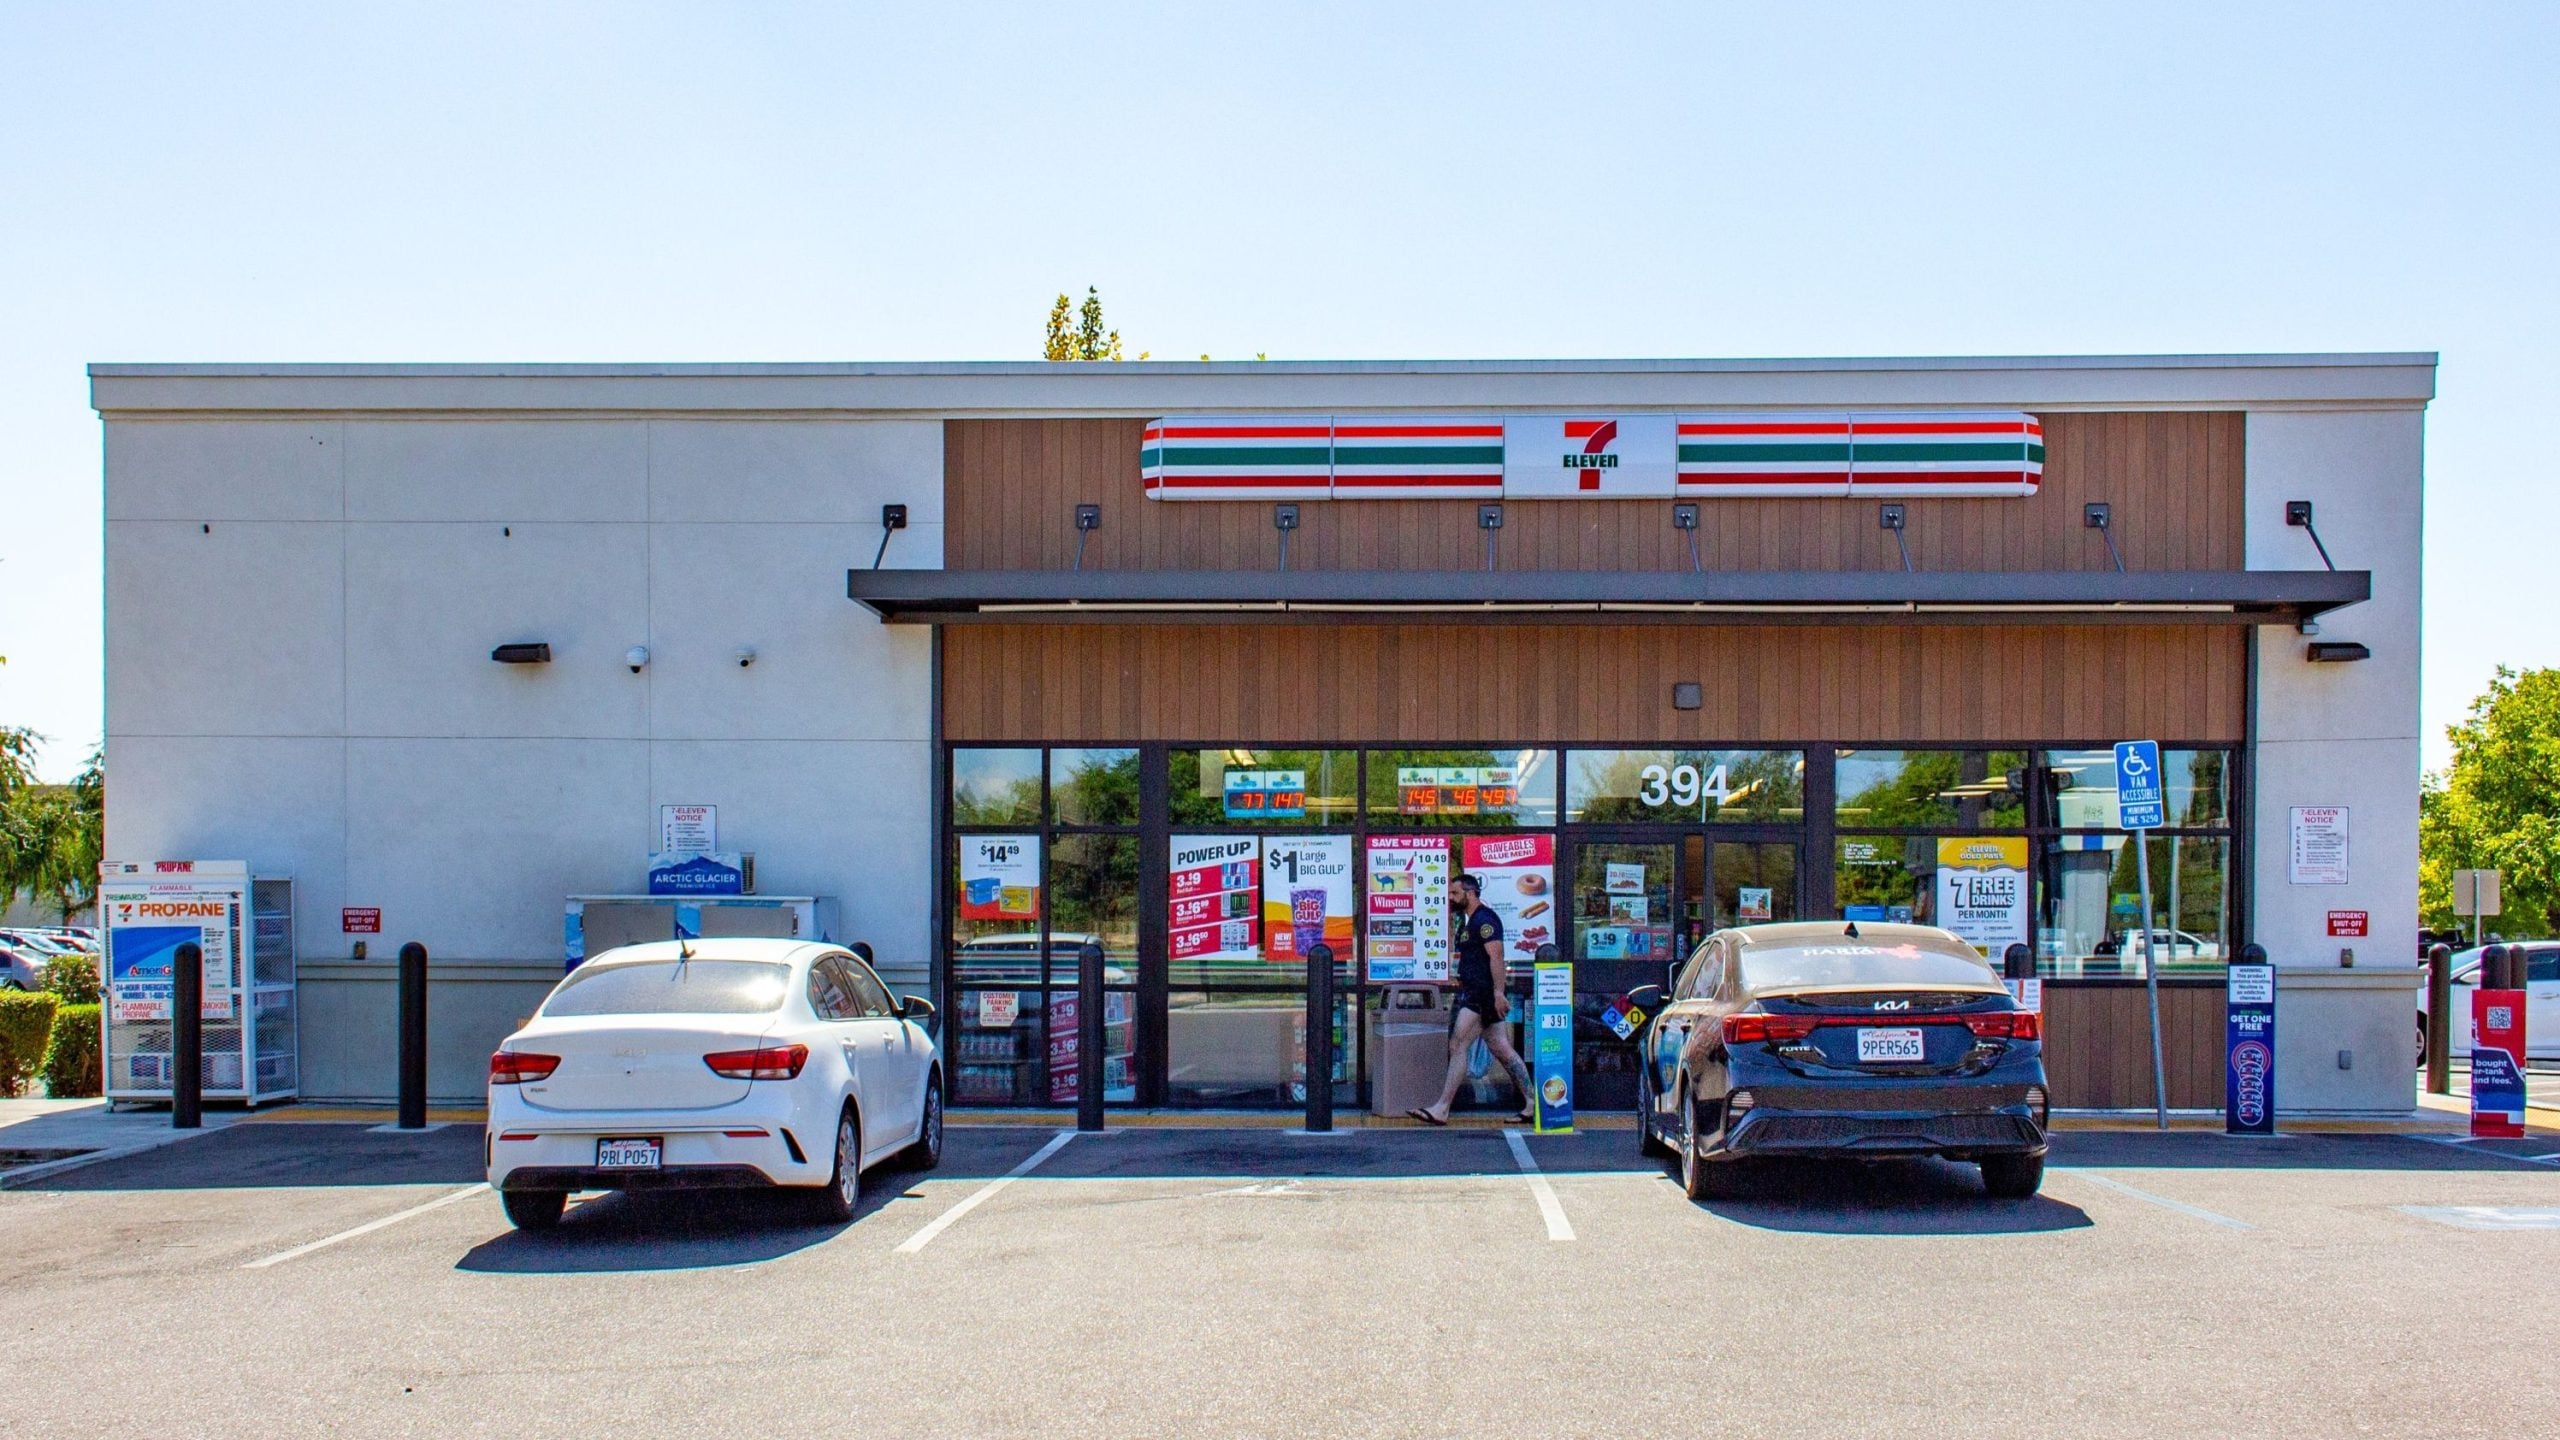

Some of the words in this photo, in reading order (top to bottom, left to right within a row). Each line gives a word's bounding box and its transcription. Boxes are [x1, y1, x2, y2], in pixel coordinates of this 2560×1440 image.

[1640, 764, 1730, 807] 394
[2130, 776, 2147, 788] VAN
[1243, 793, 1264, 808] 77
[1275, 793, 1303, 808] 147
[1407, 789, 1437, 805] 145
[1453, 789, 1476, 805] 46
[2121, 788, 2158, 802] ACCESSIBLE
[2127, 805, 2154, 815] MINIMUM
[2124, 816, 2139, 825] FINE
[1371, 838, 1399, 847] SAVE
[1413, 838, 1436, 847] BUY
[1437, 838, 1445, 847] 2
[1481, 839, 1534, 855] CRAVEABLES
[1177, 845, 1224, 865] POWER
[1226, 841, 1251, 857] UP
[1300, 851, 1326, 863] Large
[1482, 851, 1509, 861] VALUE
[1510, 848, 1535, 857] MENU
[156, 861, 193, 872] PROPANE
[1269, 848, 1298, 883] $1
[1375, 853, 1407, 867] Marlboro
[1300, 865, 1316, 875] BIG
[1319, 864, 1344, 875] GULP
[655, 874, 692, 883] ARCTIC
[694, 874, 736, 883] GLACIER
[1176, 874, 1185, 887] 3
[1970, 876, 2015, 894] FREE
[1950, 876, 1970, 908] 7
[1374, 896, 1410, 907] Winston
[1970, 893, 2015, 908] DRINKS
[139, 903, 225, 917] PROPANE
[1176, 903, 1185, 917] 3
[1295, 911, 1321, 921] GULP
[1958, 910, 1976, 919] PER
[1976, 910, 2007, 919] MONTH
[1176, 935, 1185, 948] 3
[1590, 933, 1599, 945] 3
[129, 964, 173, 976] AmeriG
[121, 1002, 163, 1010] FLAMMABLE
[1873, 1000, 1910, 1010] KIA
[122, 1010, 151, 1018] PROPANE
[1050, 1006, 1058, 1020] 3
[1607, 1011, 1617, 1024] 3
[2230, 1015, 2249, 1023] GET
[2250, 1015, 2272, 1023] ONE
[1617, 1023, 1630, 1033] SA
[2239, 1023, 2263, 1031] FREE
[1871, 1031, 1907, 1040] California
[1050, 1042, 1058, 1056] 3
[1862, 1040, 1919, 1056] 9PER565
[2475, 1060, 2507, 1069] bought
[1052, 1076, 1060, 1090] 3
[2473, 1076, 2489, 1084] and
[600, 1149, 657, 1165] 9BLP057
